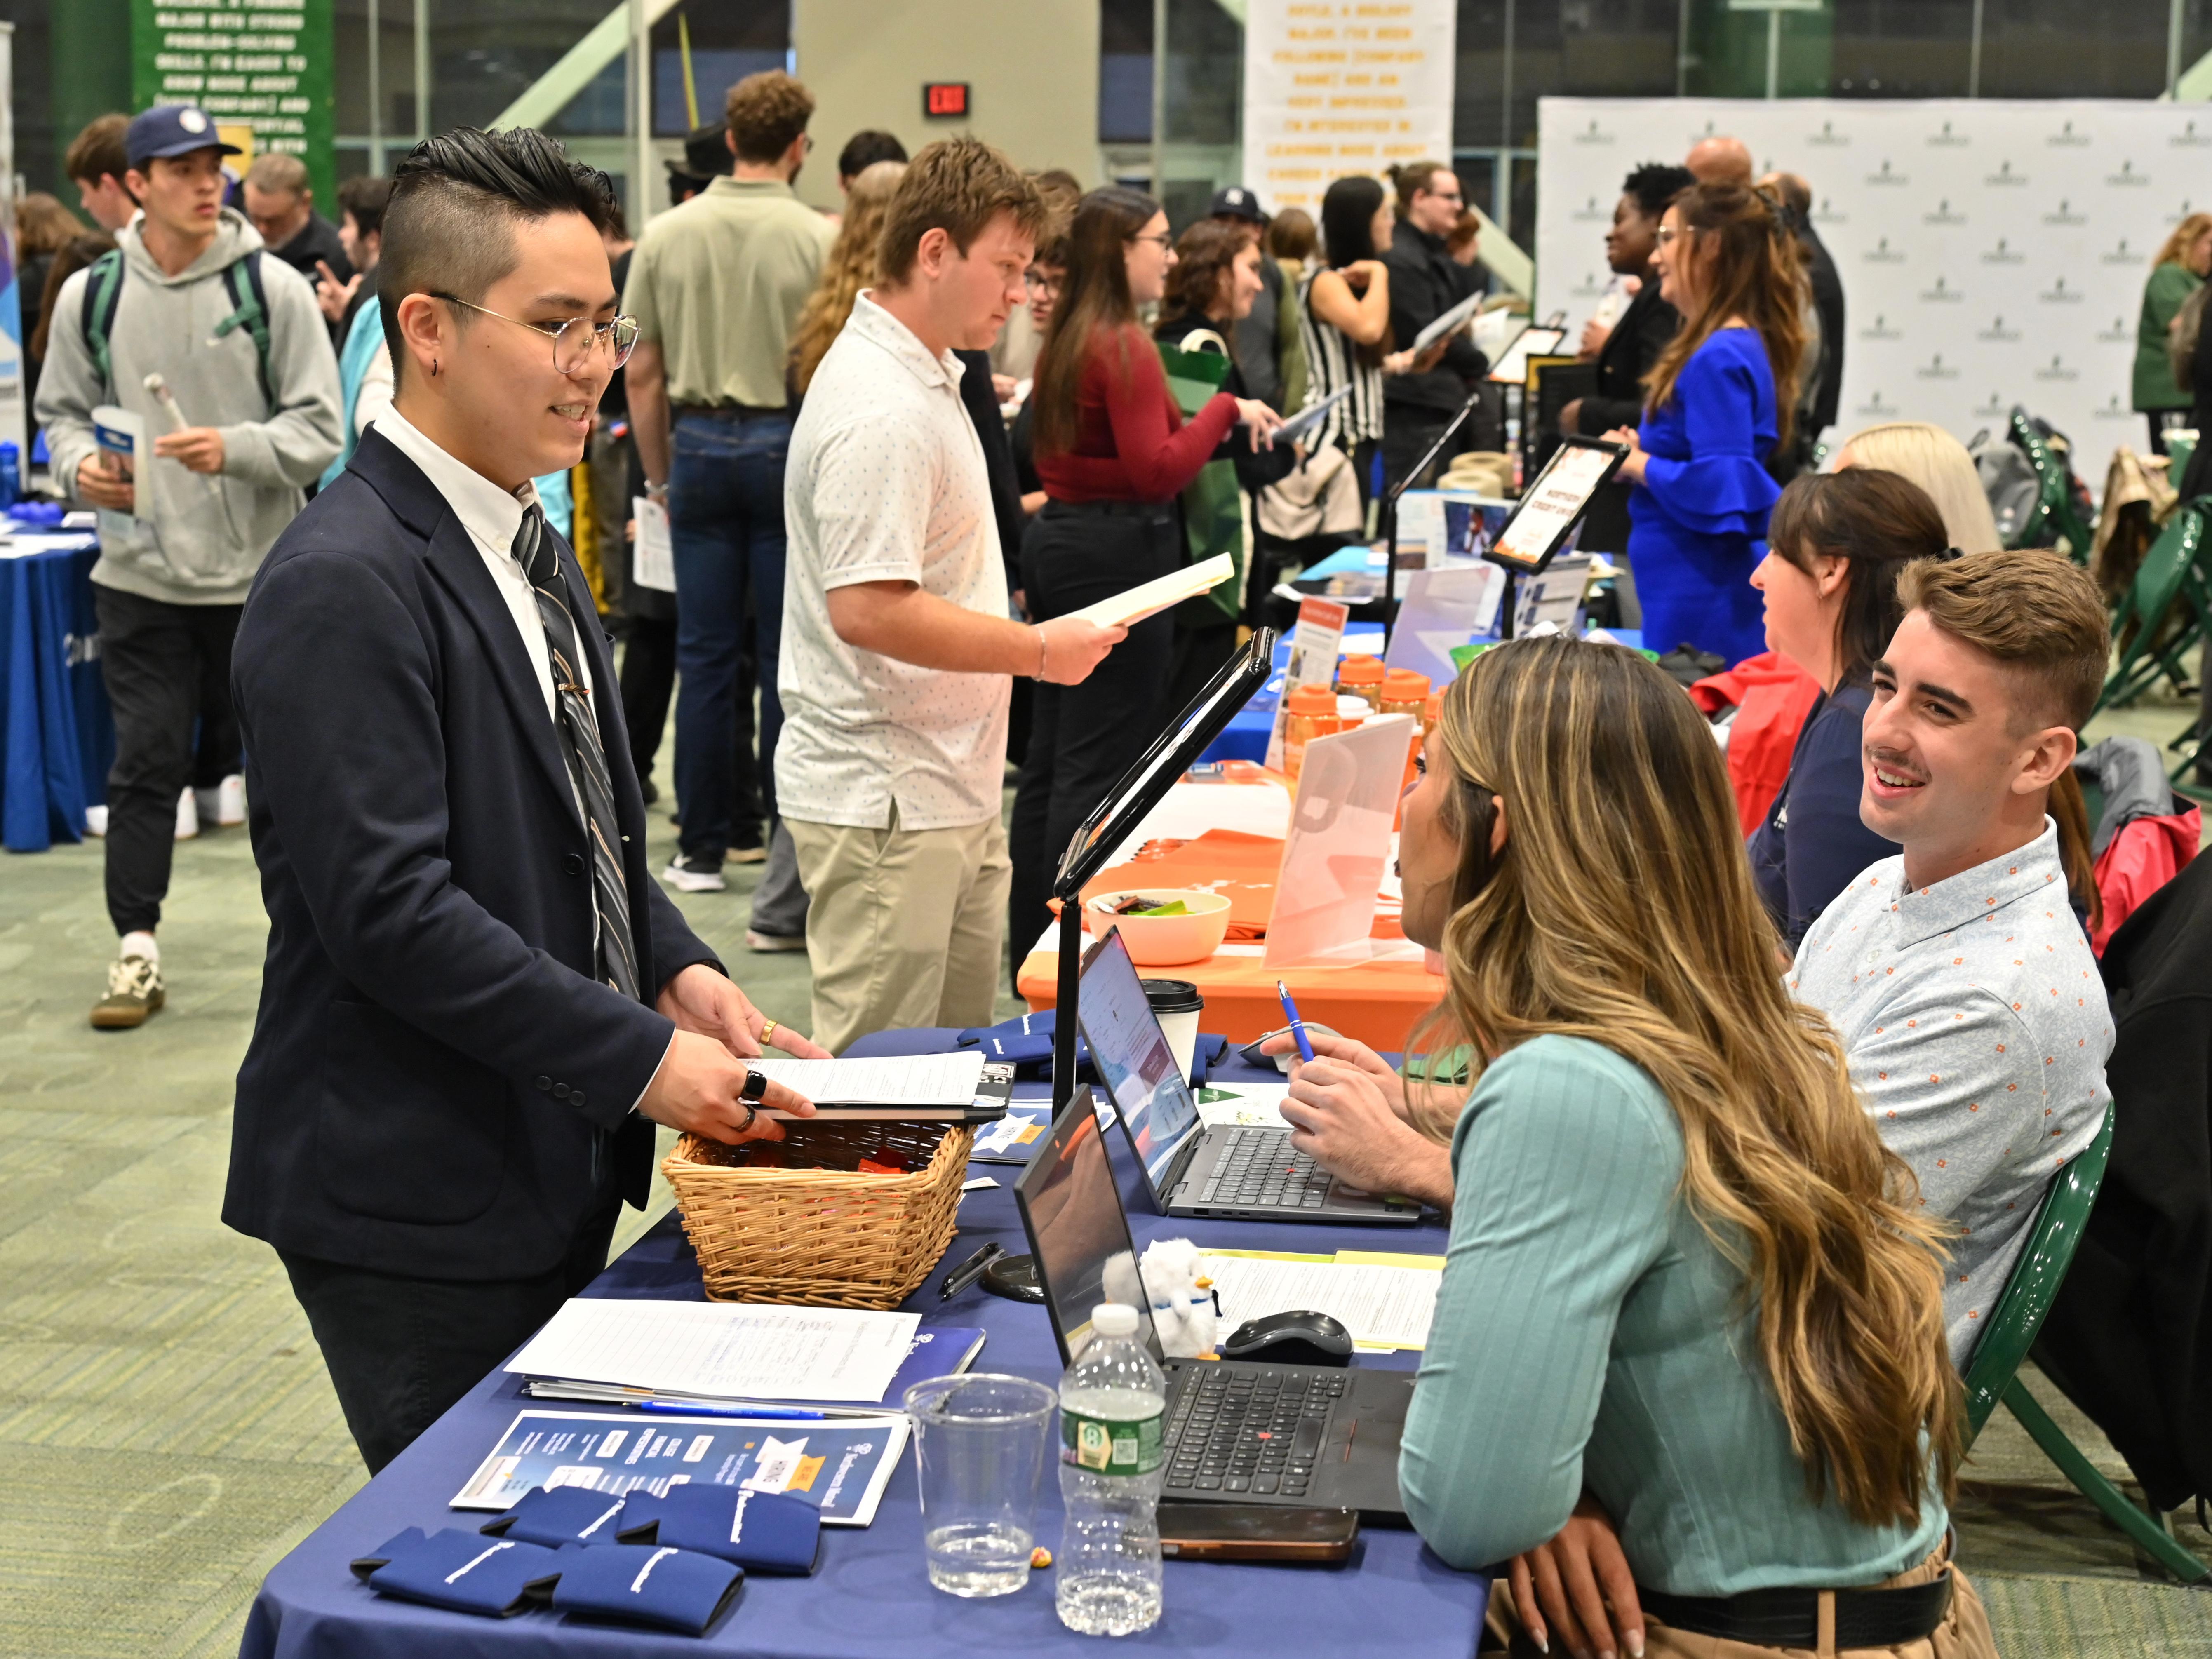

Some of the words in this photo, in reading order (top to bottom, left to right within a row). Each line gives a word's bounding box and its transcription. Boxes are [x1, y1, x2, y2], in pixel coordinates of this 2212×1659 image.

[155, 12, 205, 28] MAJOR
[209, 13, 245, 29] WITH
[248, 14, 304, 30] STRONG
[165, 33, 296, 51] PROBLEM-SOLVING
[1376, 28, 1412, 40] BEEN
[234, 55, 282, 71] EAGER
[286, 56, 307, 72] TO
[1273, 51, 1347, 63] FOLLOWING
[163, 75, 204, 91] KNOW
[206, 75, 246, 92] MORE
[250, 76, 298, 92] ABOUT
[1345, 75, 1371, 86] AND
[1379, 75, 1398, 86] AM
[201, 95, 277, 115] COMPANY]
[279, 96, 310, 113] AND
[930, 86, 964, 112] EXIT
[1287, 97, 1323, 108] VERY
[1308, 120, 1391, 132] INTERESTED
[1397, 120, 1410, 132] IN
[270, 138, 307, 154] WITH
[1267, 145, 1332, 157] LEARNING
[1339, 145, 1375, 157] MORE
[1382, 144, 1426, 157] ABOUT
[1268, 169, 1322, 180] CAREER
[763, 1460, 788, 1483] HIRING
